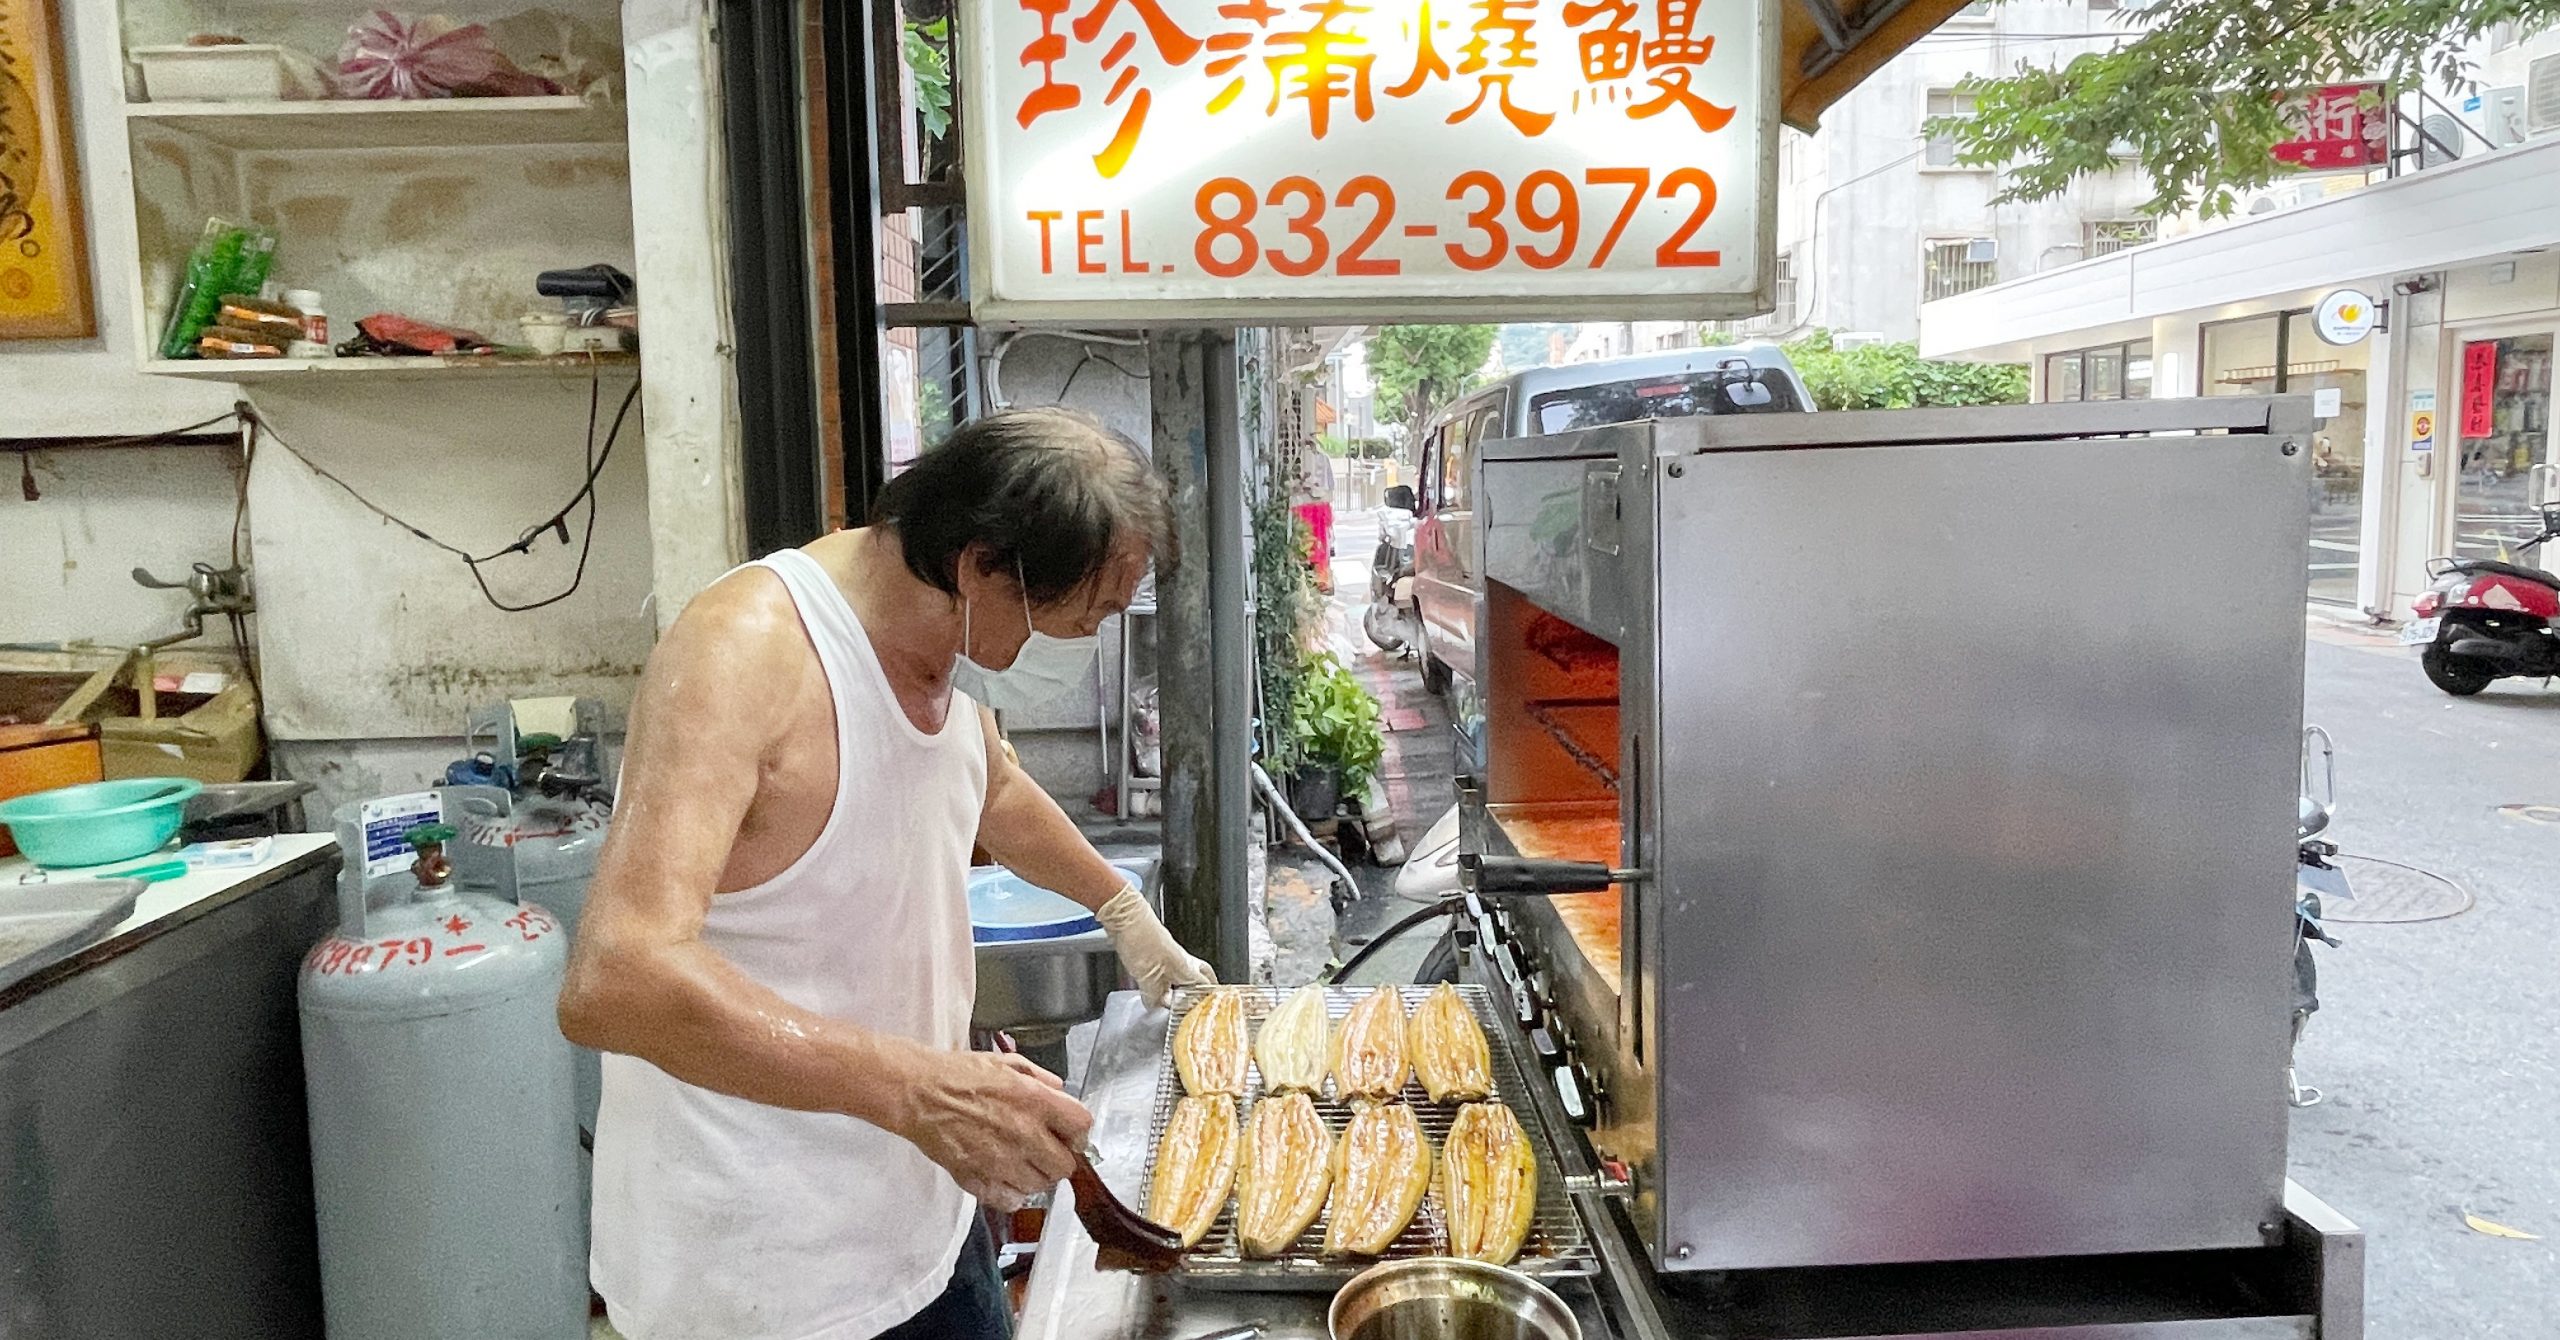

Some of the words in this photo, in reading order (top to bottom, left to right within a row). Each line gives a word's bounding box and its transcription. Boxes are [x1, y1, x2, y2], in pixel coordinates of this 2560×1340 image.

[1016, 0, 1737, 179] 珍蒲燒鰻
[1027, 210, 1175, 274] TEL.
[1194, 167, 1721, 278] 832-3972
